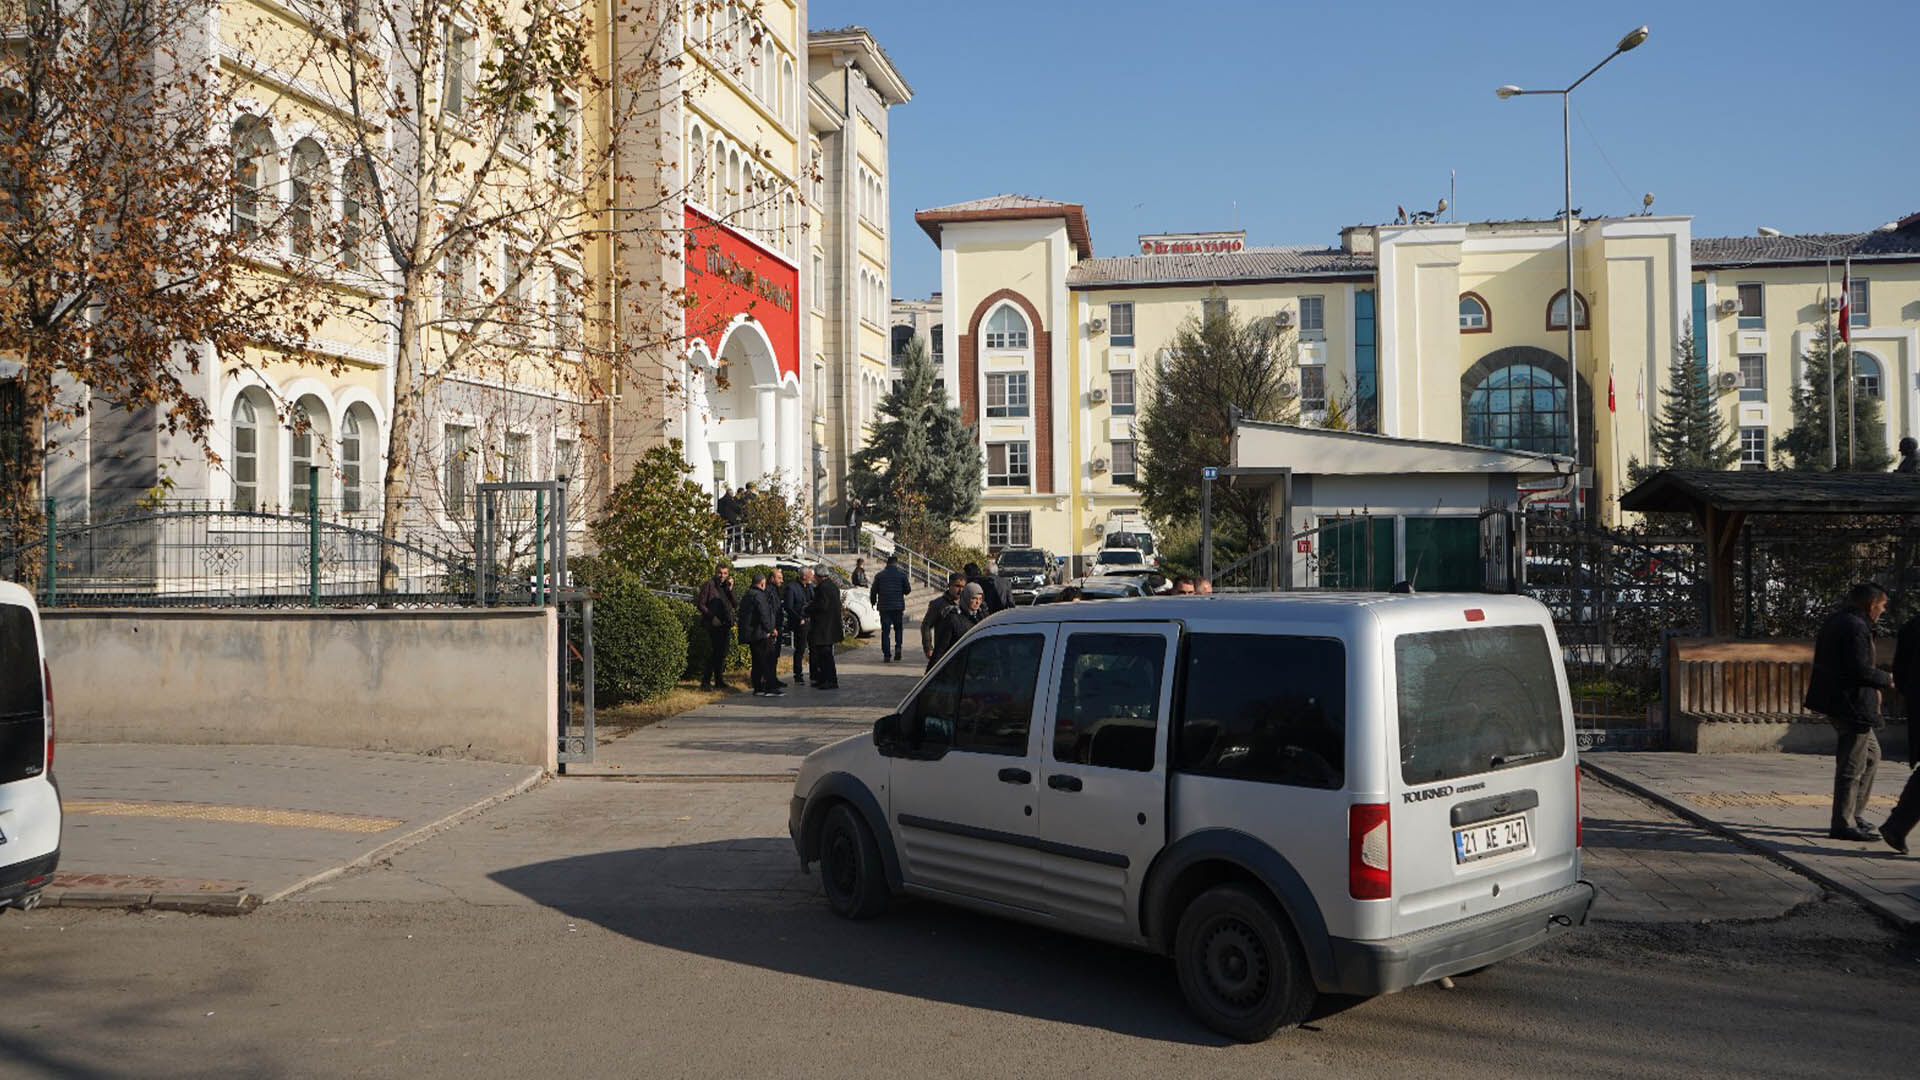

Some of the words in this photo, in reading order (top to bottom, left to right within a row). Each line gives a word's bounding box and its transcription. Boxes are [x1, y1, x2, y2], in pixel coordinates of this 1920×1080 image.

[1401, 785, 1454, 804] TOURNEO
[1463, 831, 1478, 854] 21
[1486, 827, 1499, 849] AE
[1505, 821, 1522, 845] 247
